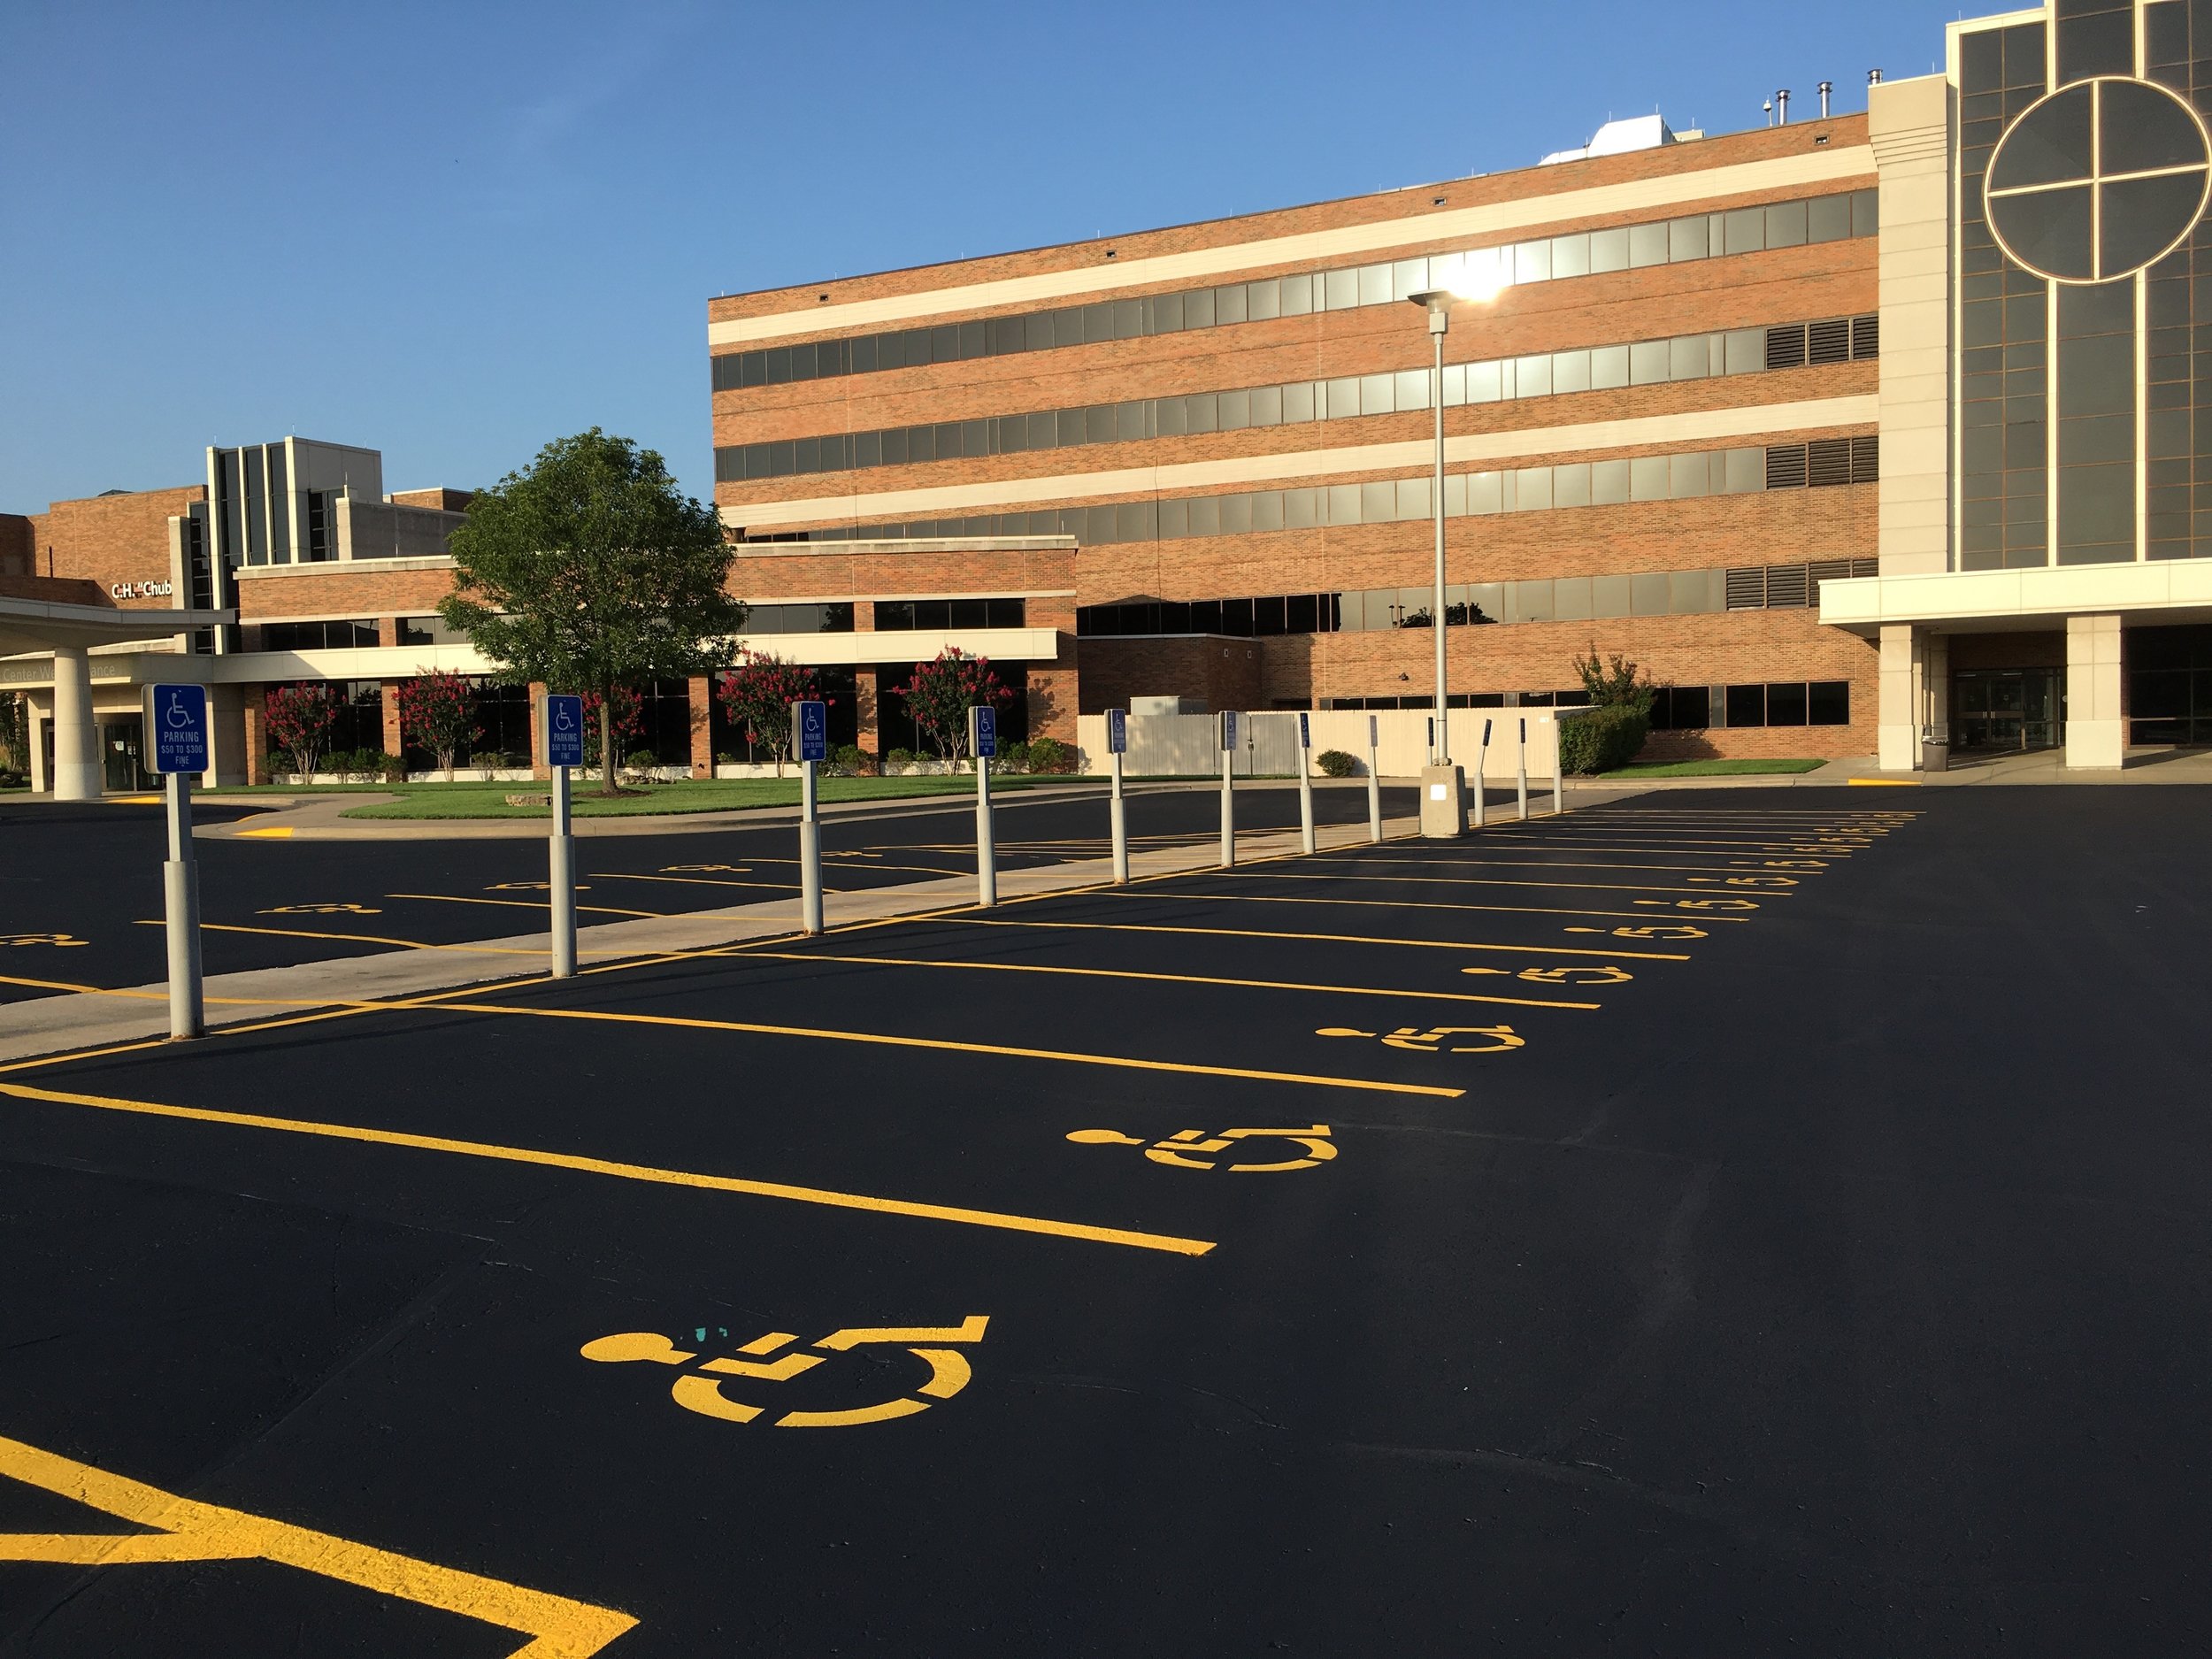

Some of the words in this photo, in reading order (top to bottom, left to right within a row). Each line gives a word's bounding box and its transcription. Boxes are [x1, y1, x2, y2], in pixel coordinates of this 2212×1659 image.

[111, 582, 135, 598] C.H.
[4, 668, 36, 681] Center
[164, 731, 199, 742] PARKING
[553, 733, 577, 741] PARKING
[161, 744, 174, 754] $50
[176, 745, 184, 754] TO
[186, 744, 204, 754] $300
[175, 756, 189, 764] FINE
